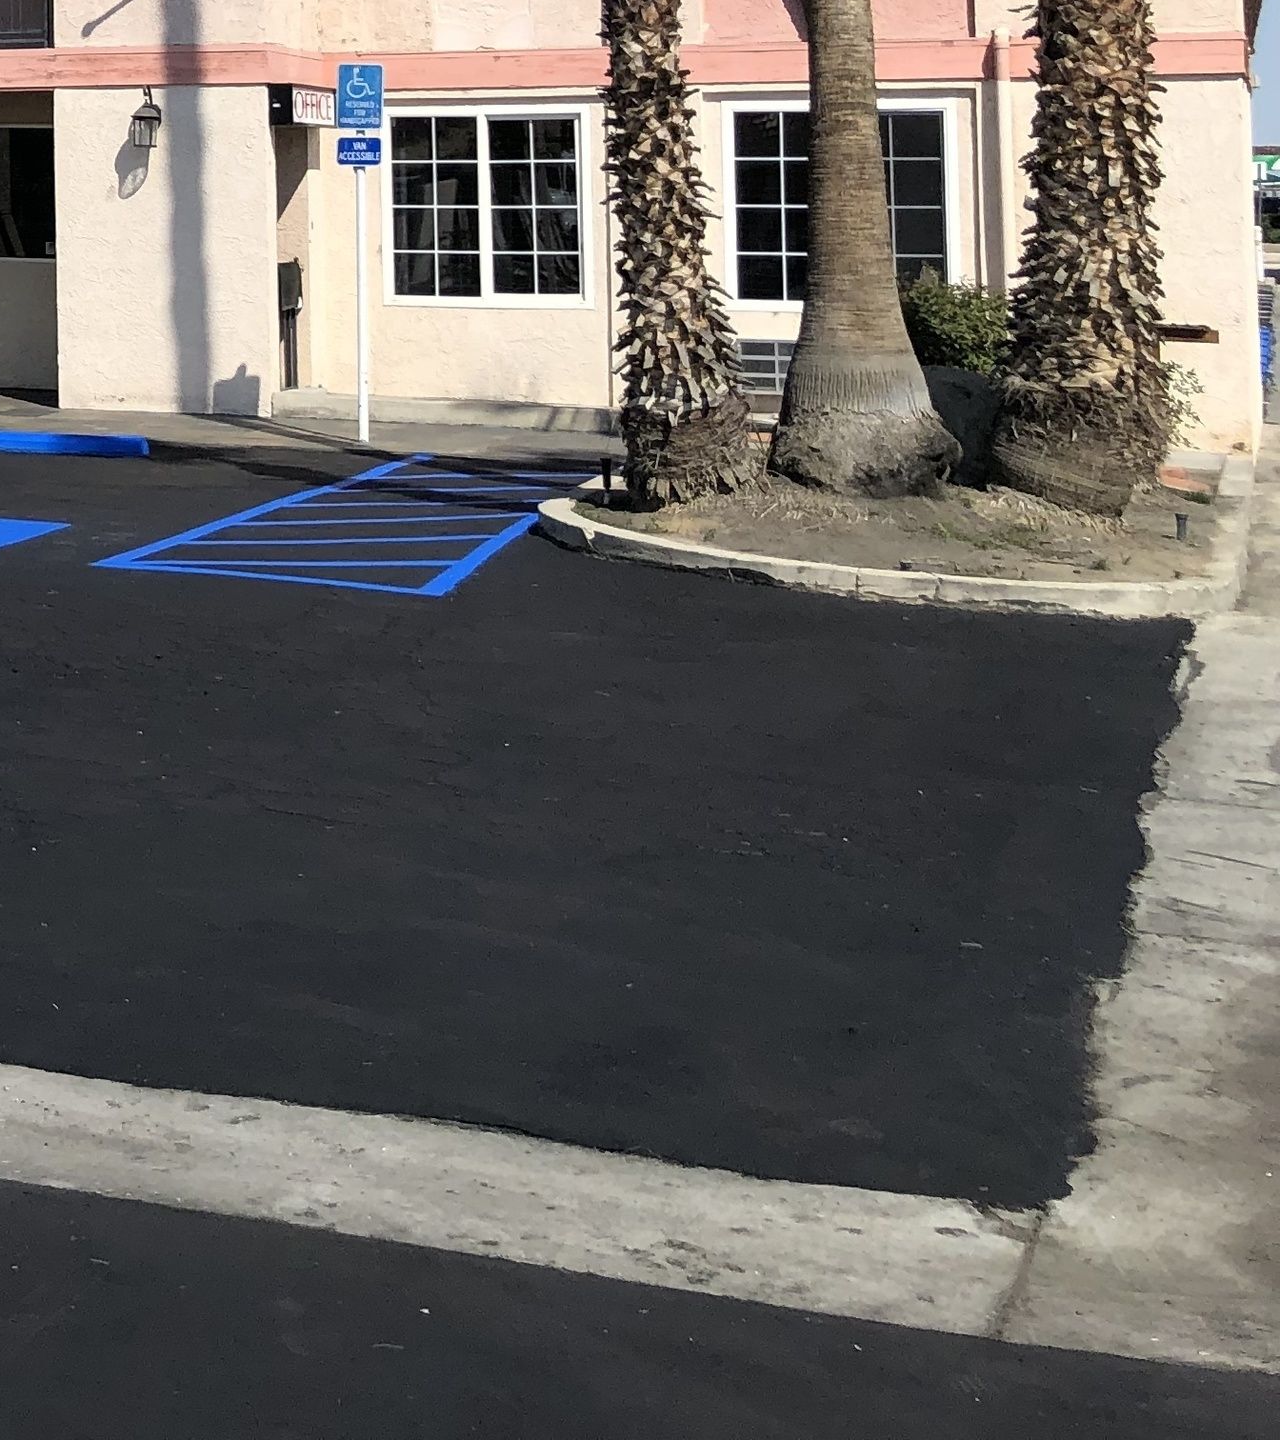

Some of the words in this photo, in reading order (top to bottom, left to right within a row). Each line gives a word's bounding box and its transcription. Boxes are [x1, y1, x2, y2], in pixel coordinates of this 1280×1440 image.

[294, 91, 332, 120] OFFICE
[352, 141, 367, 150] VAN
[338, 151, 381, 161] ACCESSIBLE
